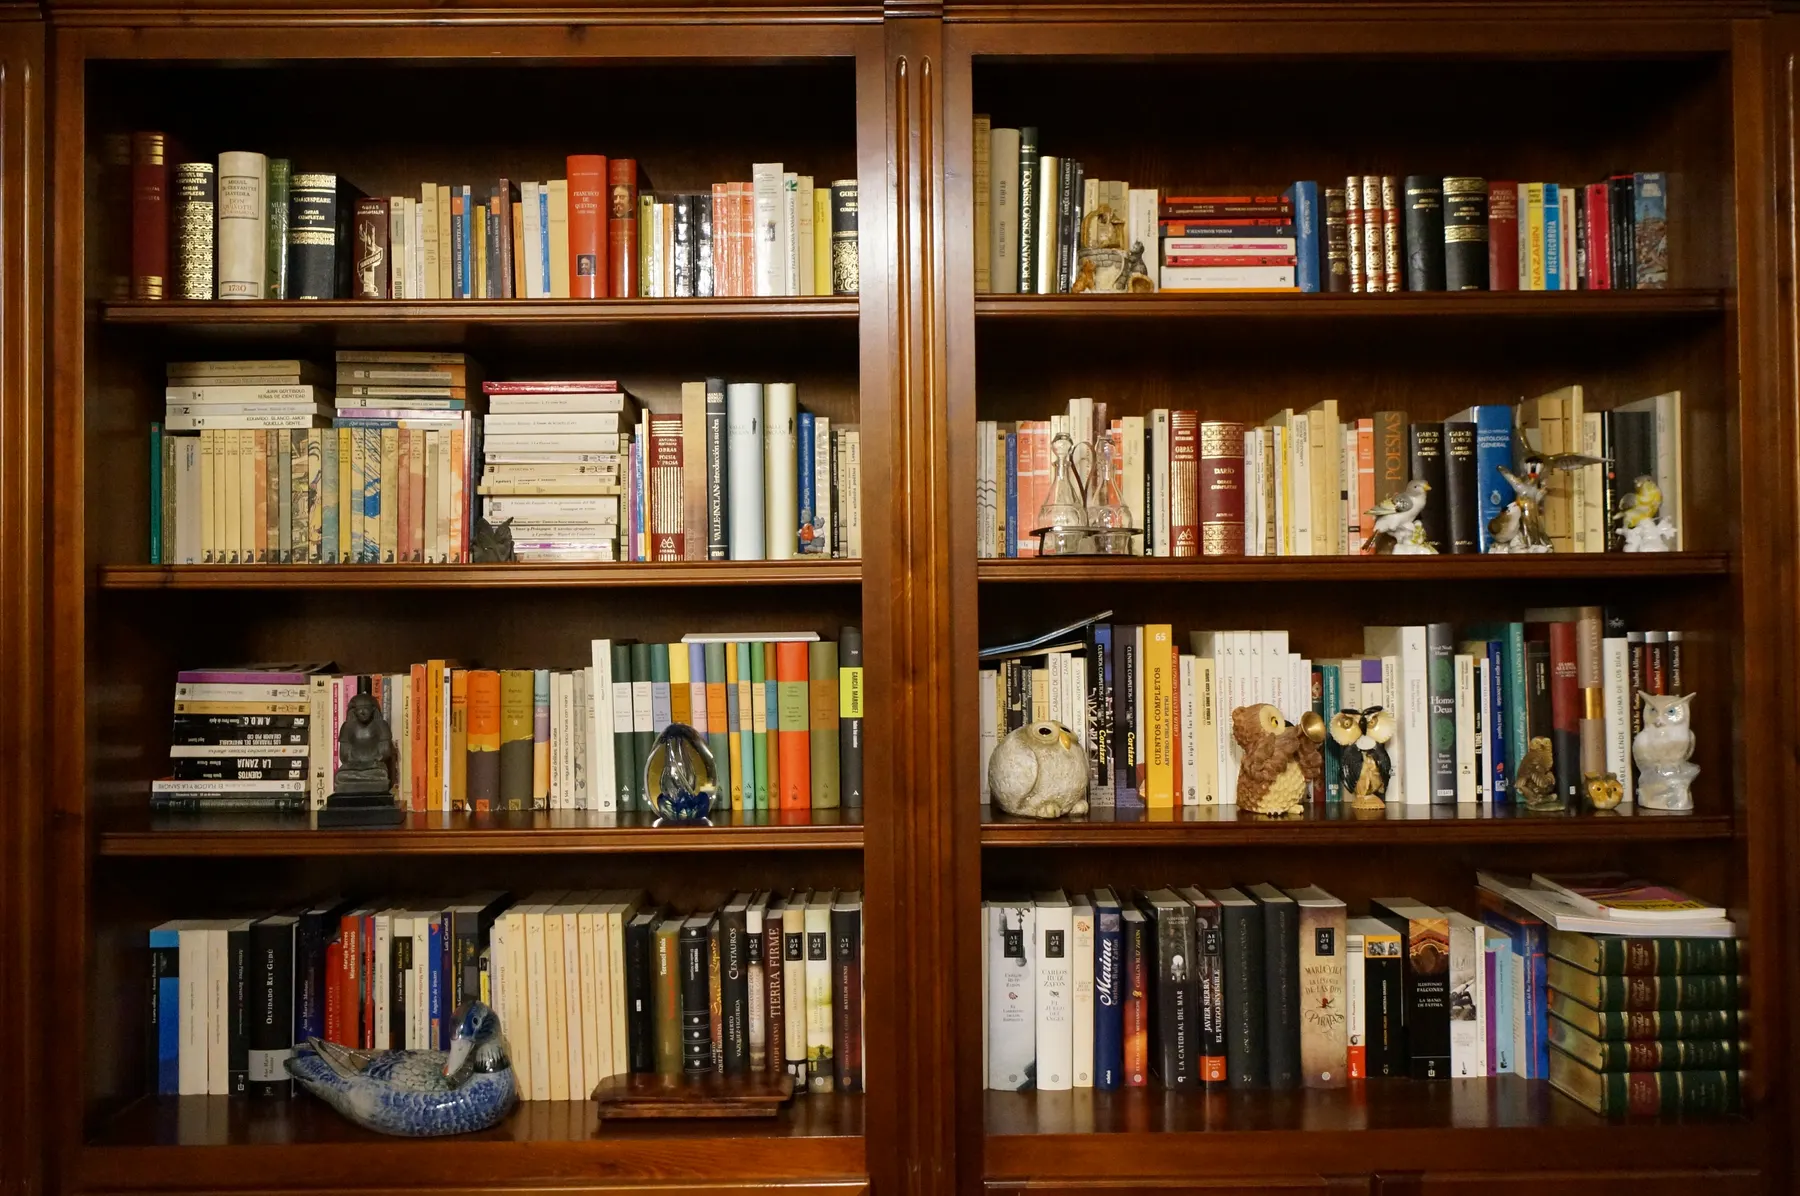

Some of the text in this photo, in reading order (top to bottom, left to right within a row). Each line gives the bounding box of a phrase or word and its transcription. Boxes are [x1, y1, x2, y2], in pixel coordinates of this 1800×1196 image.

[1021, 168, 1033, 291] EL ROMANTICISMO ESPAÑOL
[1547, 220, 1557, 275] MISERICORDIA
[1385, 412, 1401, 481] POESIAS
[1214, 467, 1235, 475] DARÍO
[1155, 632, 1166, 641] 65
[1588, 656, 1598, 683] ISABEL
[1614, 651, 1622, 667] DÍAS
[1653, 648, 1661, 671] Allende
[1672, 645, 1680, 669] Allende
[1430, 696, 1455, 705] Homo
[1433, 705, 1453, 714] Deus
[1097, 729, 1106, 765] Cortázar
[1126, 731, 1135, 767] Cortázar
[1617, 730, 1625, 763] ALLENDE
[237, 758, 271, 768] ZANJA LA
[238, 770, 262, 779] CUENTOS
[728, 927, 739, 980] CENTAUROS
[768, 927, 781, 1018] TIERRA FIRME
[1096, 937, 1112, 1006] Marina
[265, 948, 274, 1024] OLVIDADO REY GUDÚ
[1213, 969, 1221, 1006] INVISIBLE
[1176, 1007, 1184, 1020] DEL
[1203, 1006, 1212, 1032] JAVIER
[1214, 1007, 1222, 1032] FUEGO
[1304, 1009, 1345, 1029] PIRATAS
